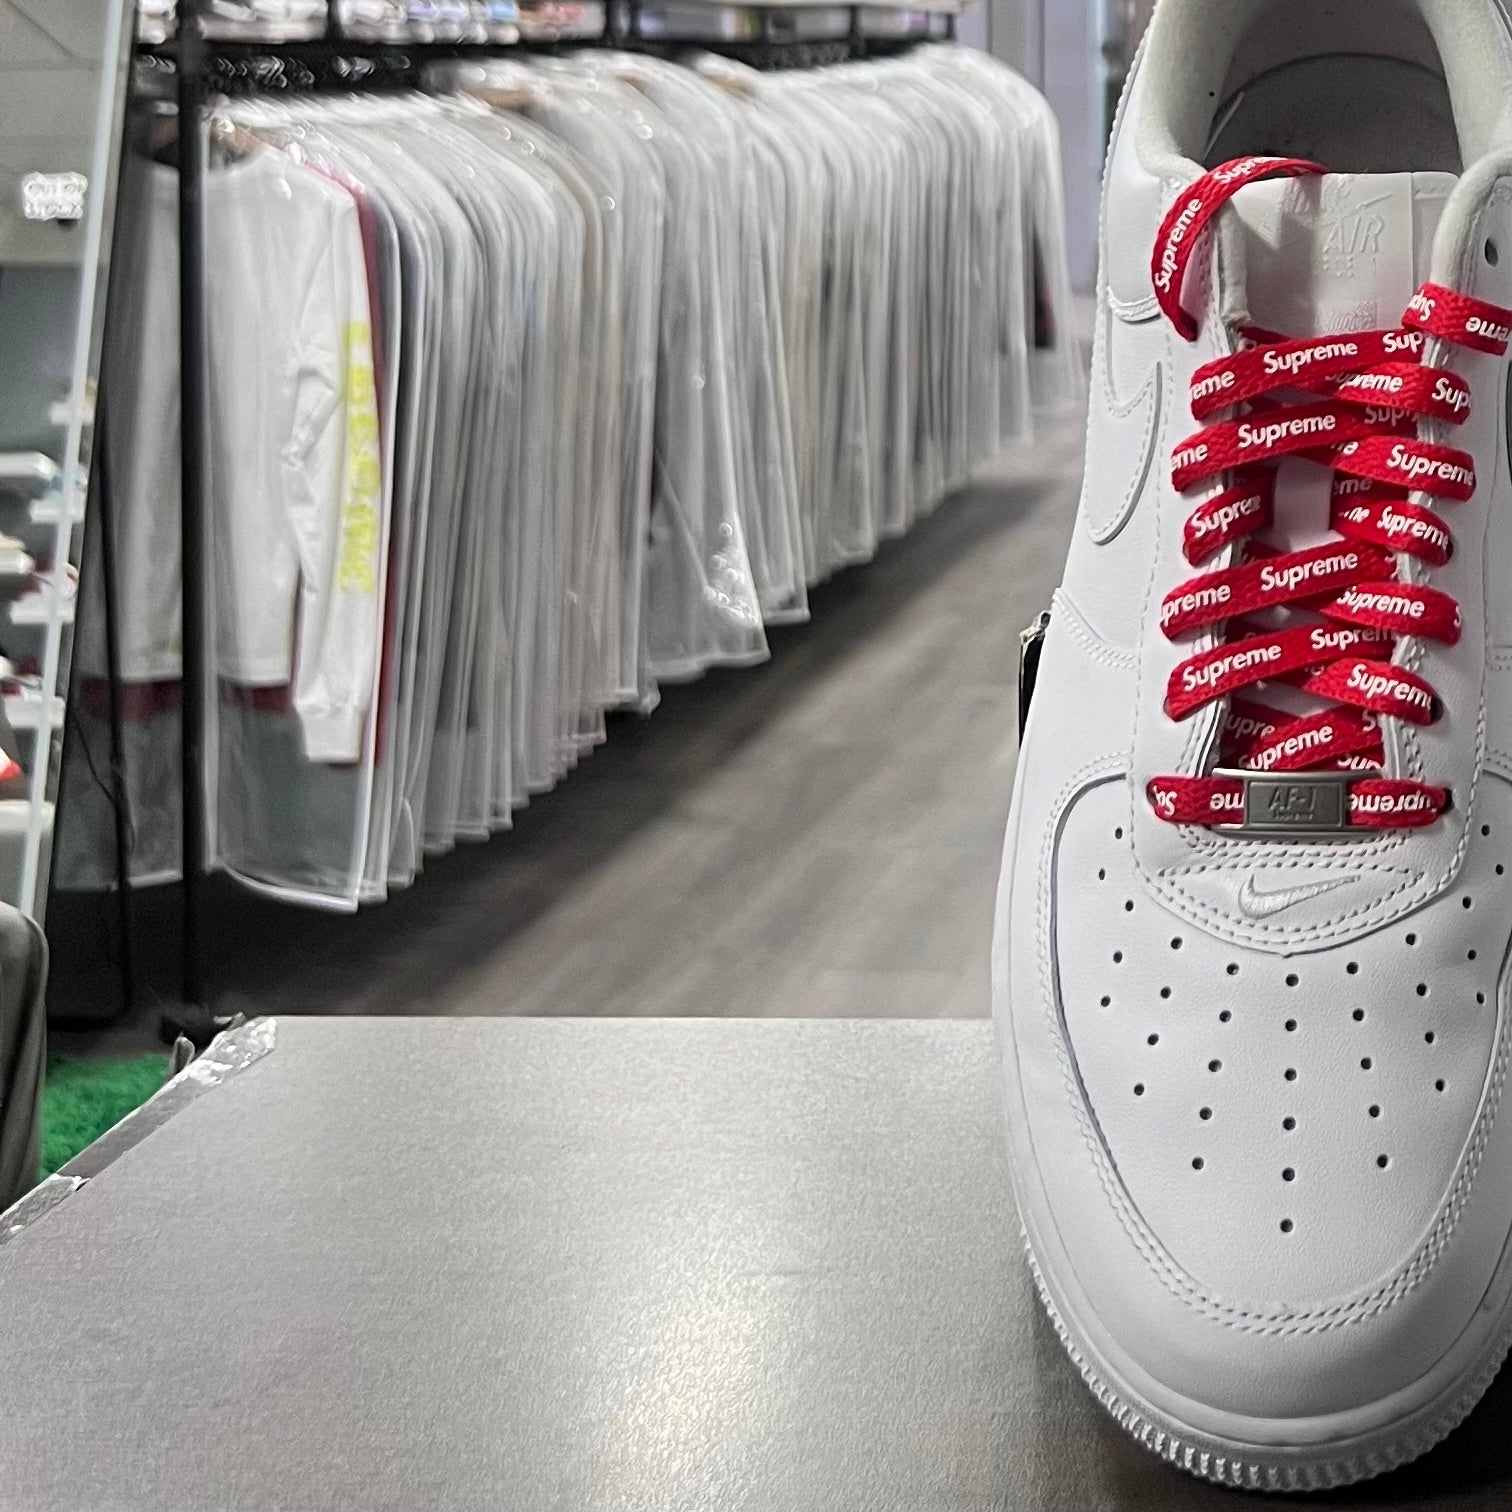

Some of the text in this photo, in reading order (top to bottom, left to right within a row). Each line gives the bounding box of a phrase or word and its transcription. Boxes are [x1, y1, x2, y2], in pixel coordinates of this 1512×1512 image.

[1154, 198, 1203, 294] Supreme
[1322, 215, 1385, 254] AIR
[1263, 342, 1358, 374] Supreme
[1238, 414, 1336, 448] Supreme
[1261, 552, 1358, 591] Supreme
[1161, 585, 1231, 626] preme
[1182, 645, 1282, 691] Supreme
[1347, 663, 1431, 710] Suprem
